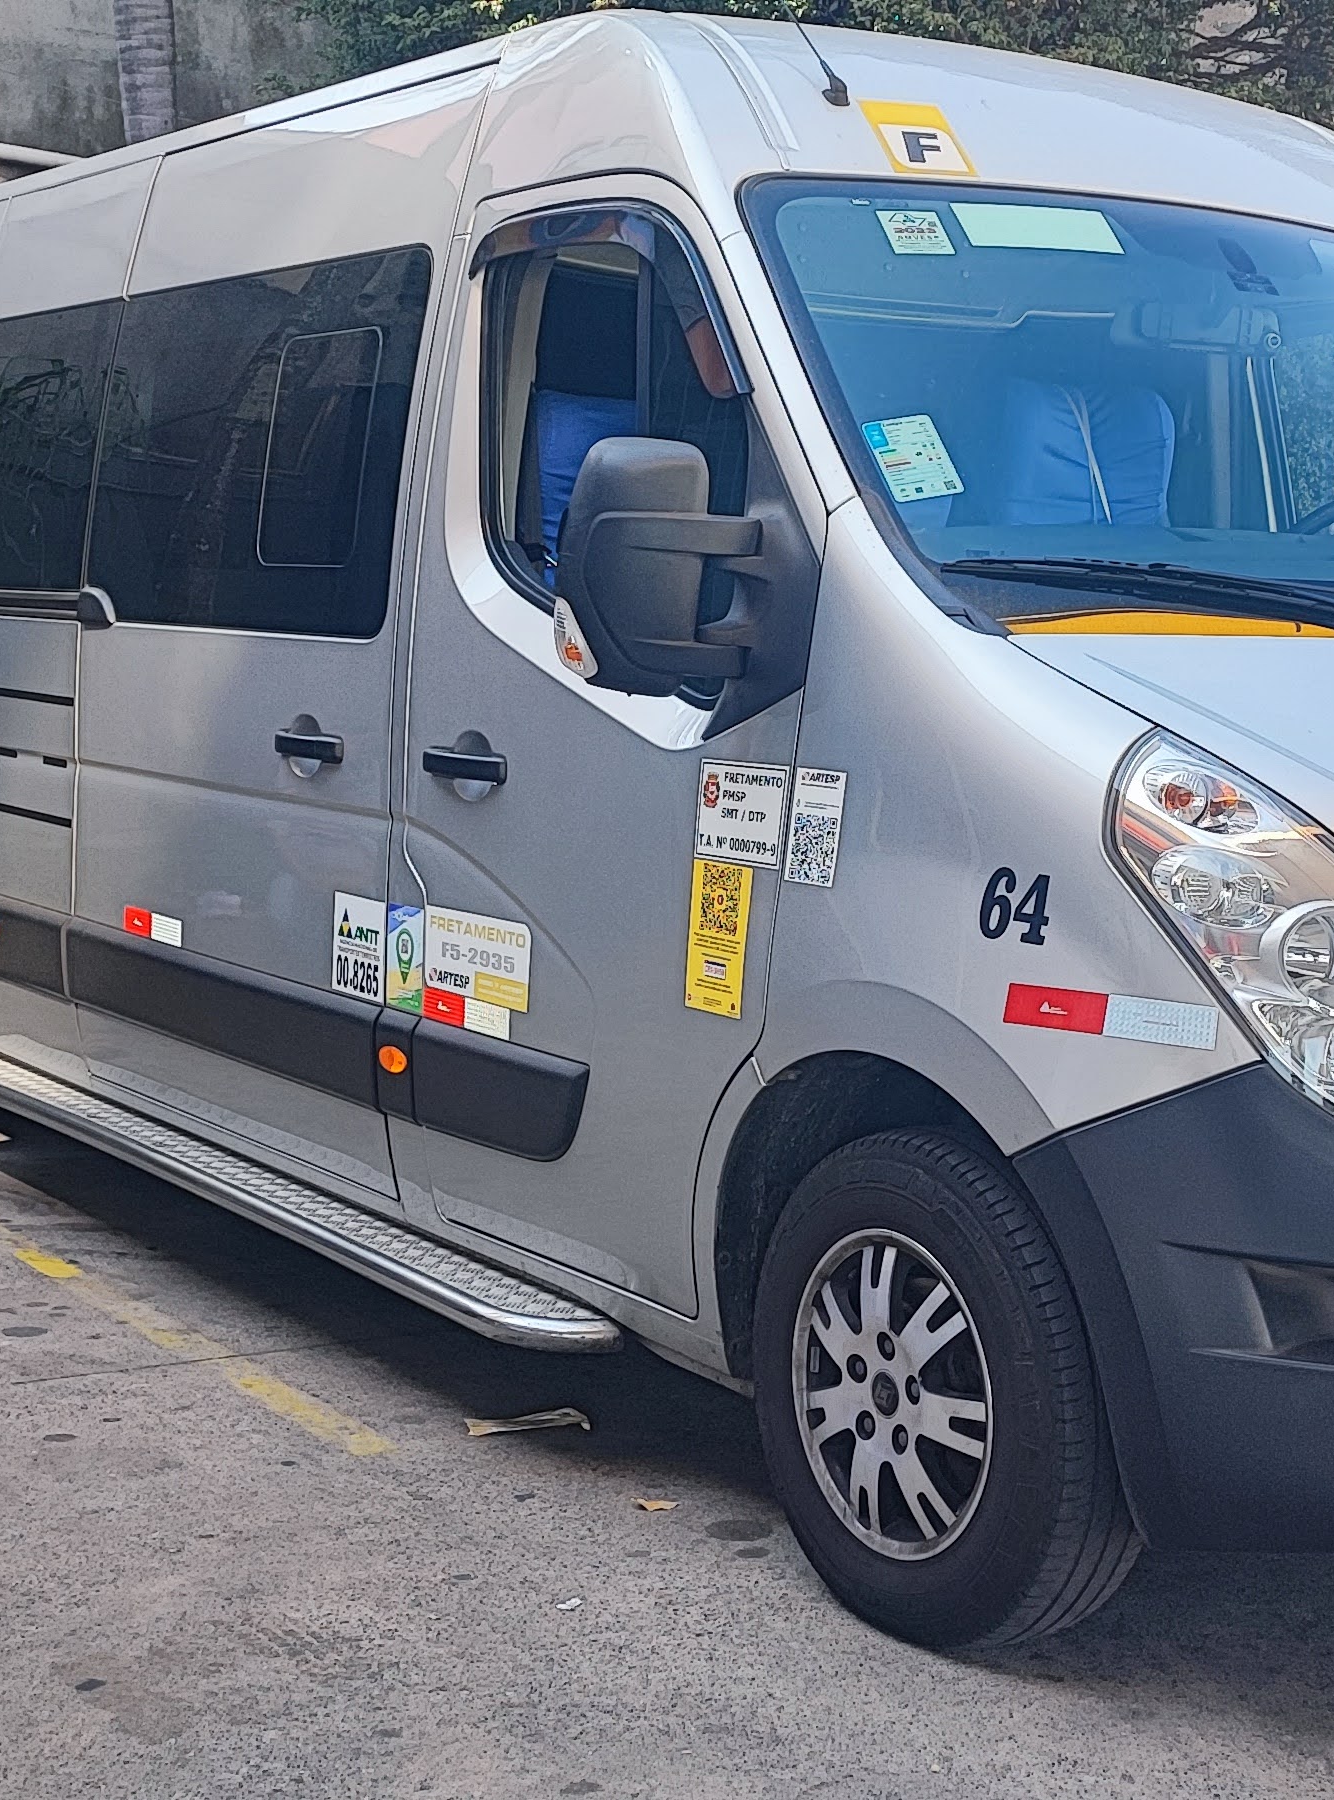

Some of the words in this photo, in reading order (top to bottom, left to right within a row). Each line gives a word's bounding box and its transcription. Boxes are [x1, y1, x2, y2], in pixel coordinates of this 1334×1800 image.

[901, 131, 941, 163] F
[724, 771, 783, 788] FRETAMENTO
[809, 772, 841, 785] ARTESP
[722, 790, 747, 802] PMSP
[720, 807, 739, 820] SMT
[748, 810, 767, 823] DTP
[979, 866, 1051, 946] 64
[354, 926, 380, 946] ANTT
[429, 914, 527, 949] FRETAMENTO
[441, 941, 516, 974] F5-2935
[336, 954, 379, 998] 00.8265
[437, 970, 470, 990] ARTESP
